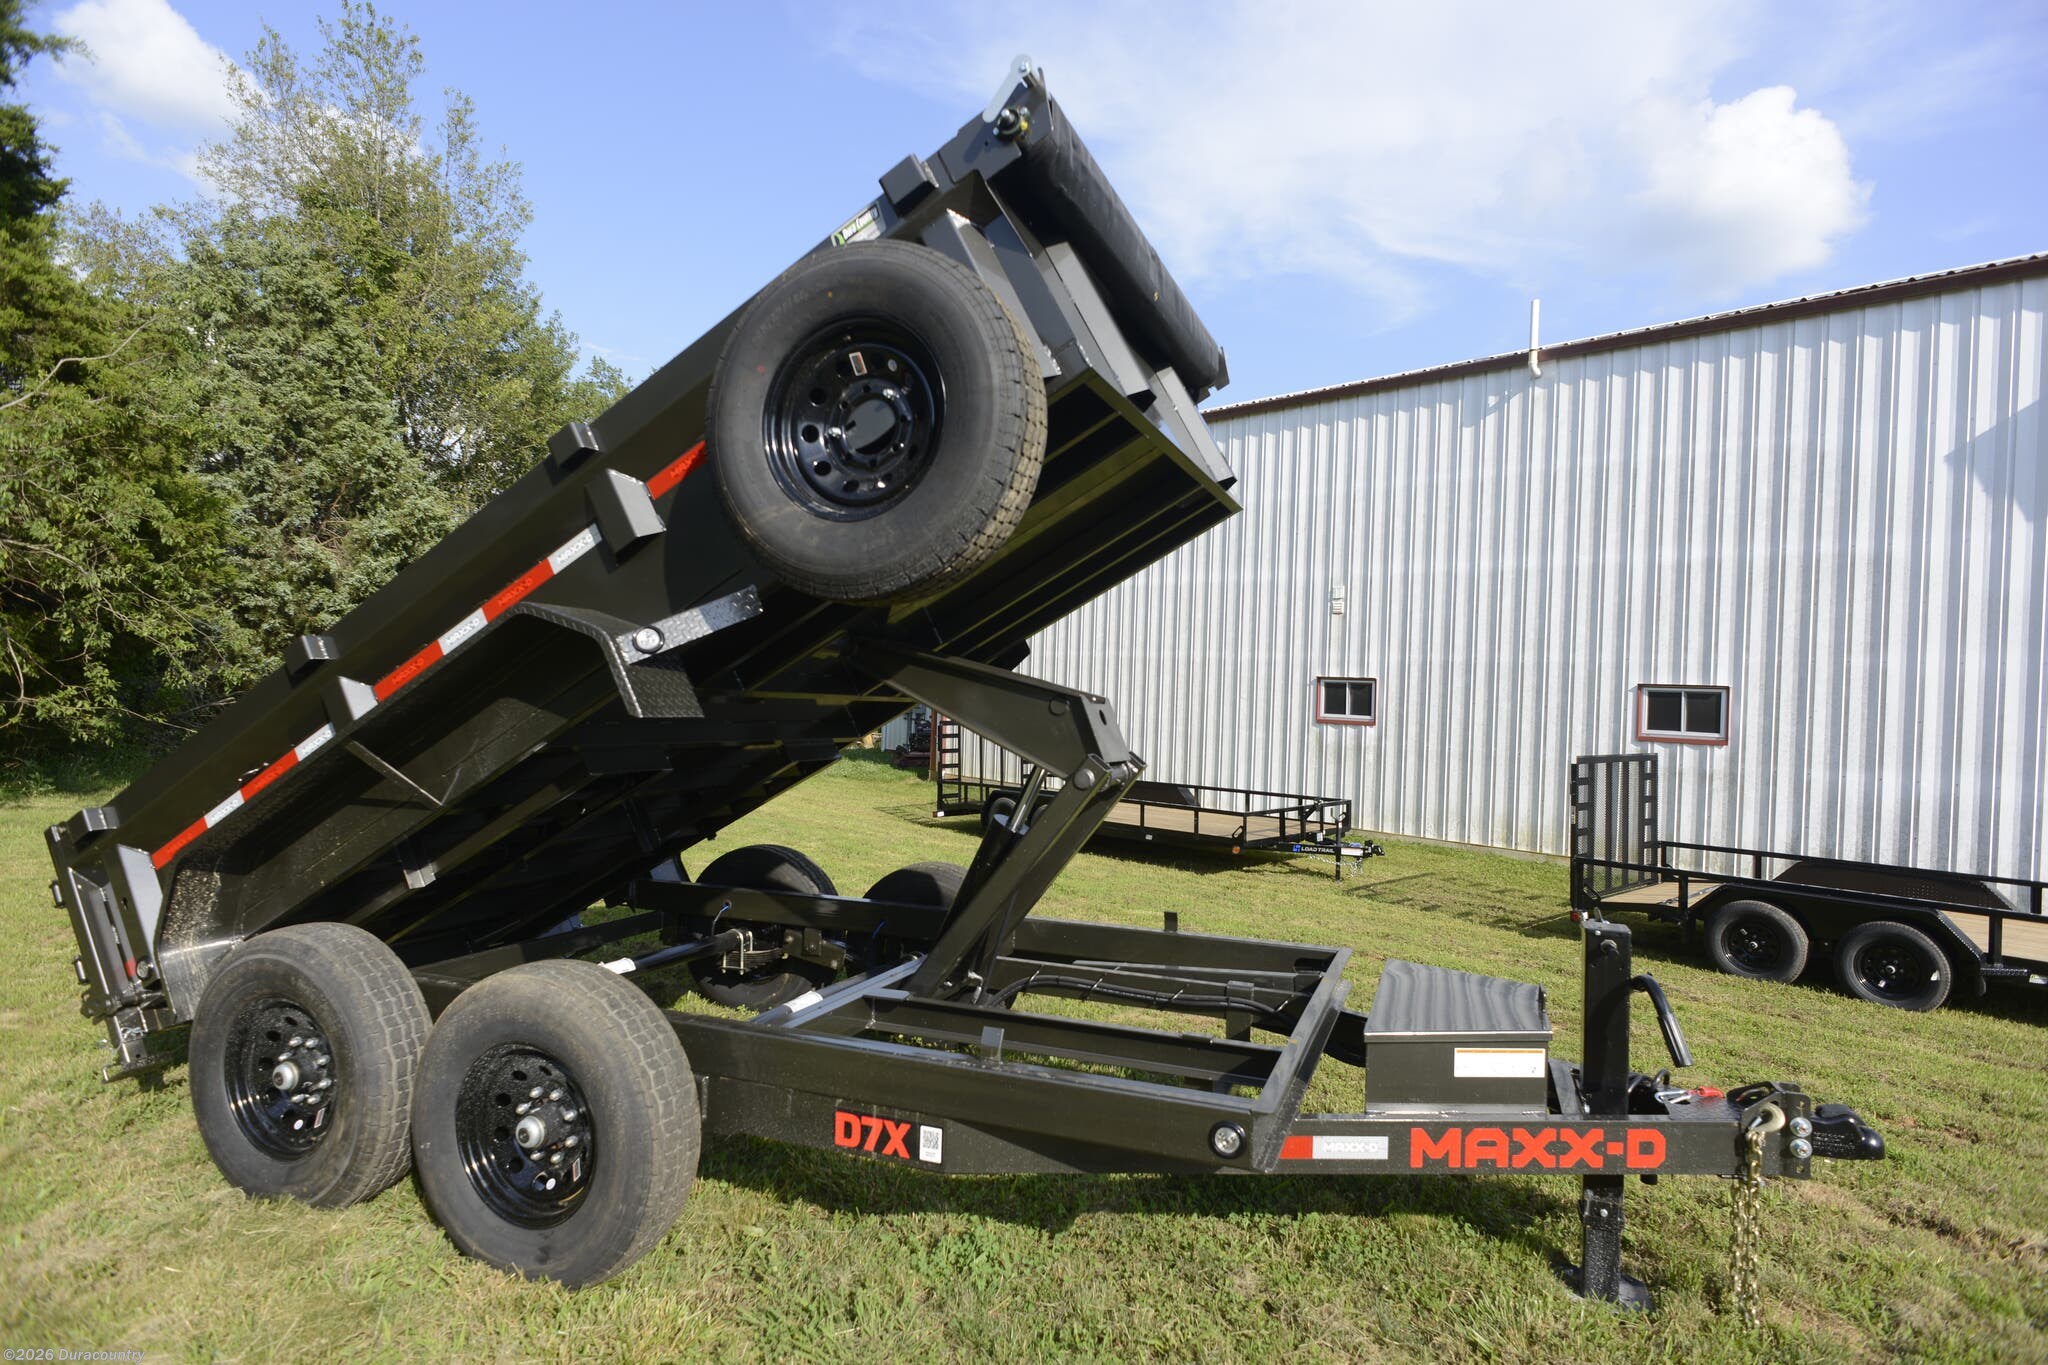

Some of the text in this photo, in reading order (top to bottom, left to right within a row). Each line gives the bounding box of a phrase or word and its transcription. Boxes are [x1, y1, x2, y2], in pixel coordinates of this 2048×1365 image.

[556, 533, 593, 564] MAXX-D
[445, 617, 480, 645] MAXX-D
[834, 1110, 912, 1160] D7X
[1323, 1142, 1378, 1153] MAXX-D
[1410, 1127, 1667, 1169] MAXX-D
